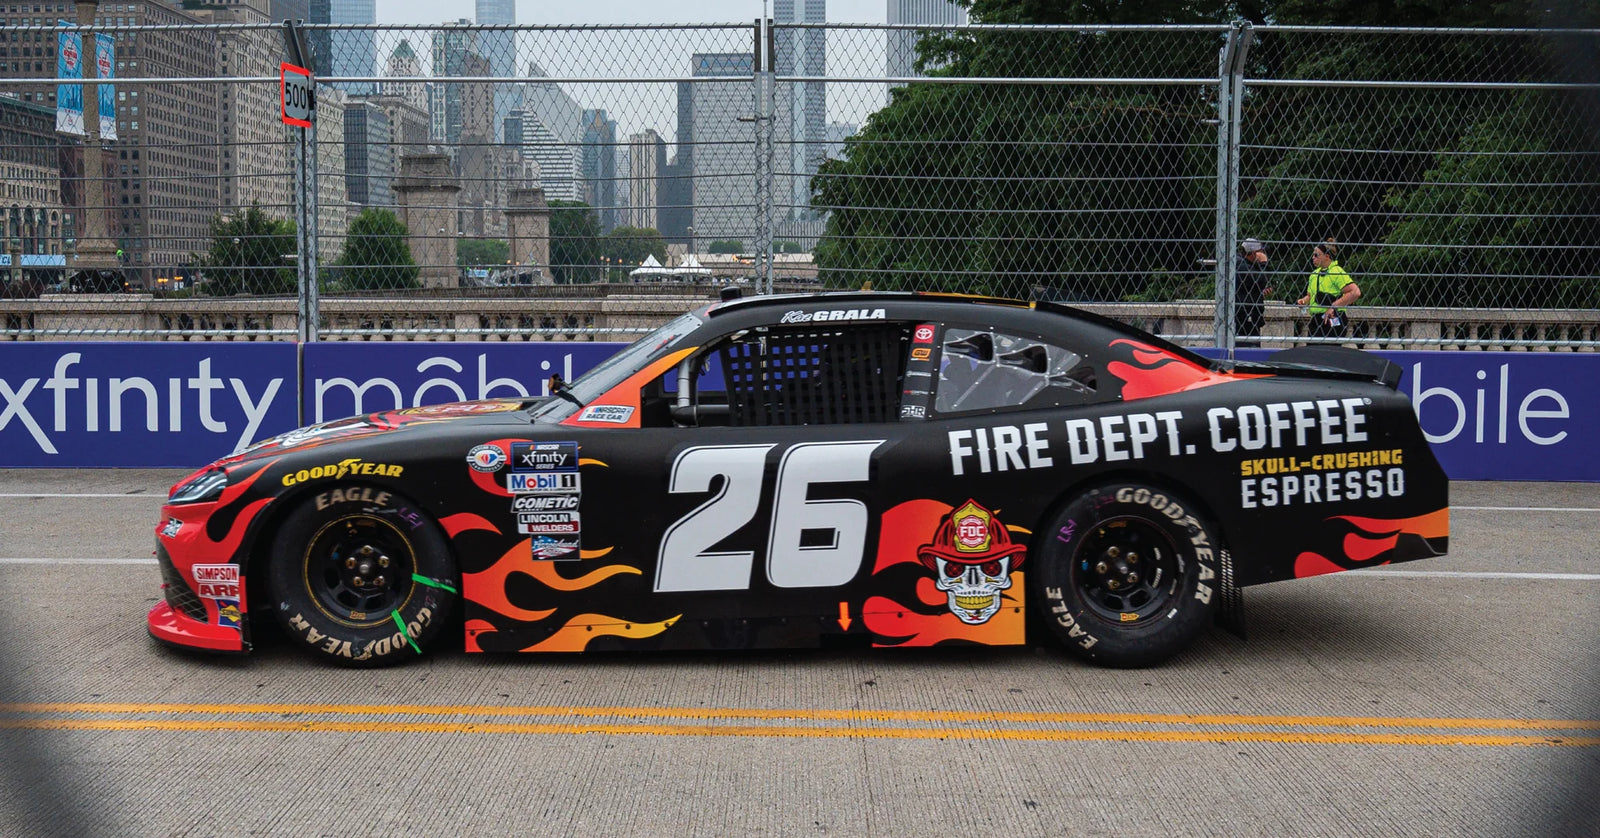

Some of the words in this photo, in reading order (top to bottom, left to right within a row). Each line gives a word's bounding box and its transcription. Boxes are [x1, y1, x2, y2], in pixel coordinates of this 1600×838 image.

[285, 82, 306, 109] 500
[813, 309, 886, 321] GRALA
[0, 352, 284, 454] xfinity
[948, 422, 1053, 476] FIRE
[1065, 411, 1196, 465] DEPT.
[1206, 398, 1368, 453] COFFEE
[522, 450, 568, 466] xfinity
[1241, 449, 1403, 477] SKULL-CRUSHING
[281, 458, 404, 487] GOODYEAR
[511, 474, 557, 489] Mobil
[564, 475, 574, 488] 1
[314, 487, 393, 511] EAGLE
[1242, 468, 1405, 509] ESPRESSO
[515, 496, 578, 509] COMETIC
[653, 439, 888, 593] 26
[521, 514, 569, 523] LINCOLN
[532, 524, 575, 532] WELDERS
[960, 526, 985, 537] FDC
[1116, 487, 1216, 605] GOODYEAR
[197, 567, 238, 580] SIMPSON
[1045, 586, 1099, 650] EAGLE
[288, 607, 432, 661] GOODYEAR
